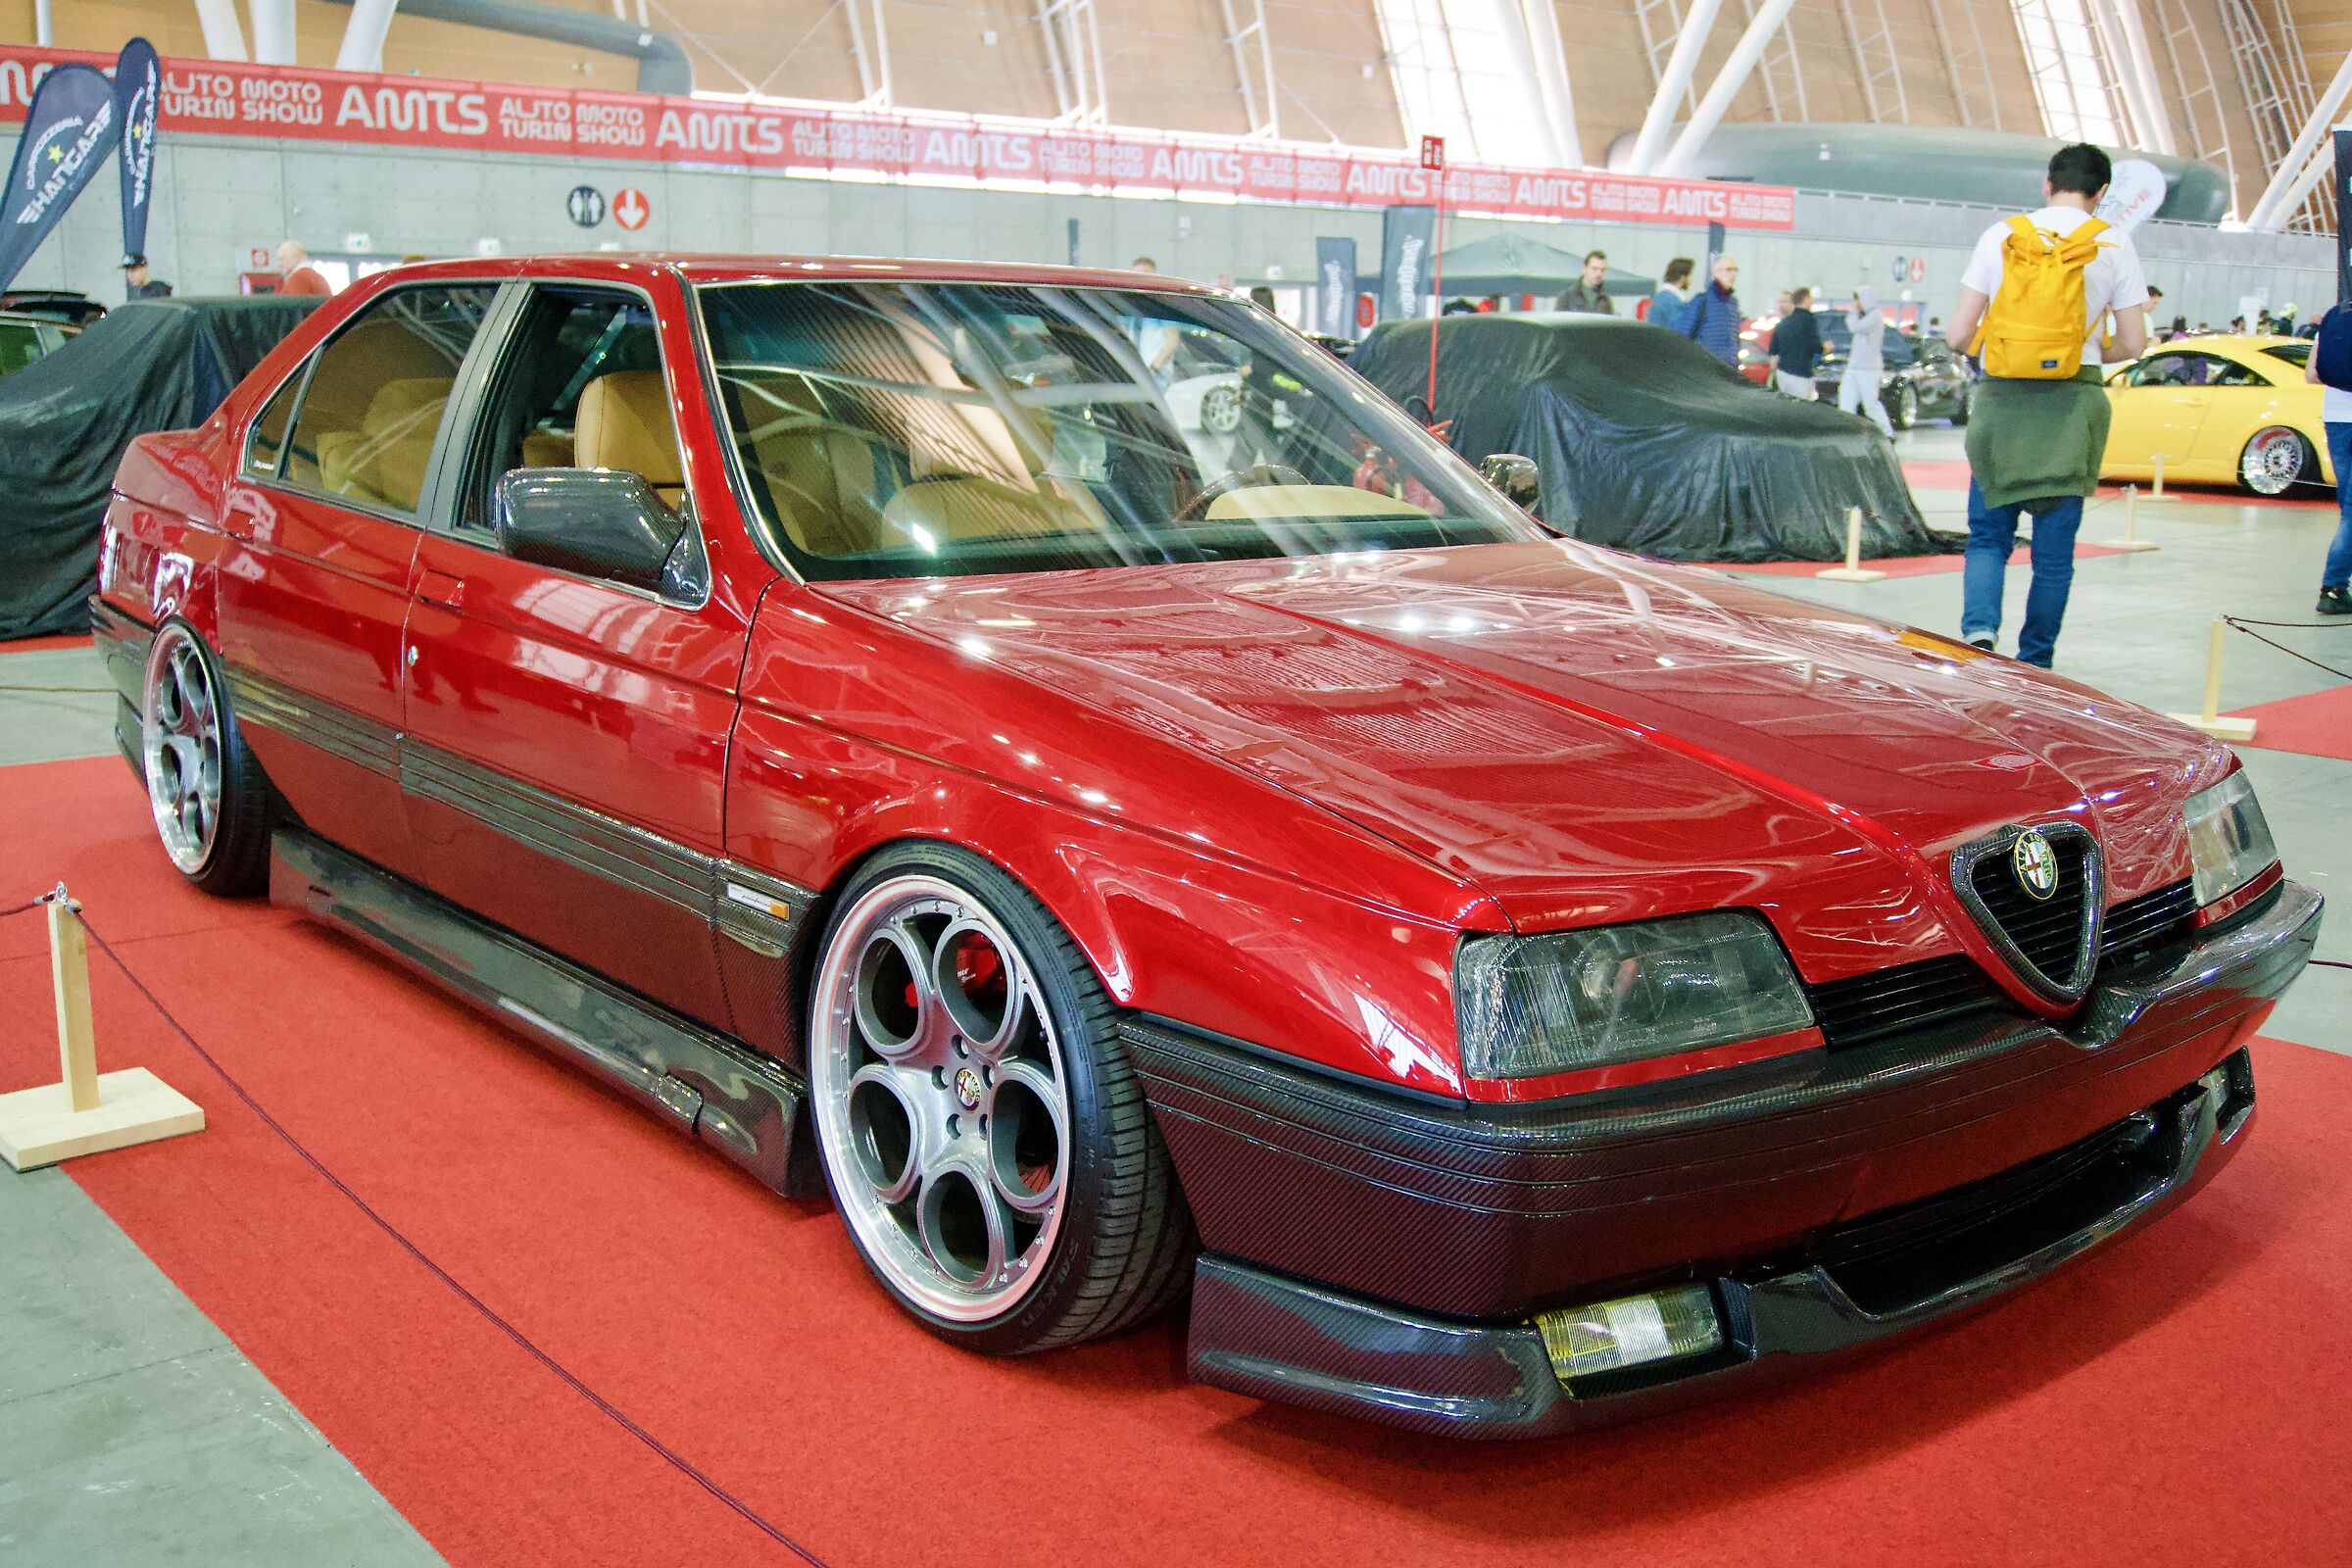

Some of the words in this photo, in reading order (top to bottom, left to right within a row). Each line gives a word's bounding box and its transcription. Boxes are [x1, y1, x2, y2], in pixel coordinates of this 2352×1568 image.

[240, 77, 322, 104] MOTO
[160, 93, 236, 121] URIN
[241, 99, 323, 125] SHOW
[335, 84, 489, 135] AMTS
[499, 97, 570, 122] AUTO
[575, 103, 644, 126] MOTO
[500, 117, 571, 141] TURIN
[576, 124, 646, 146] SHOW
[654, 109, 783, 154] AMTS
[791, 120, 854, 140] AUTO
[856, 124, 916, 144] MOTO
[792, 138, 854, 159] TURIN
[856, 143, 915, 163] SHOW
[923, 129, 1032, 171] AMTS
[1039, 140, 1091, 158] AUTO
[1093, 143, 1145, 162] MOTO
[1039, 156, 1091, 174] TURIN
[1094, 160, 1145, 178] SHOW
[1151, 148, 1245, 185] AMTS
[1345, 164, 1428, 197] AMTS
[1513, 176, 1586, 209] AMTS
[1662, 187, 1728, 218] AMTS
